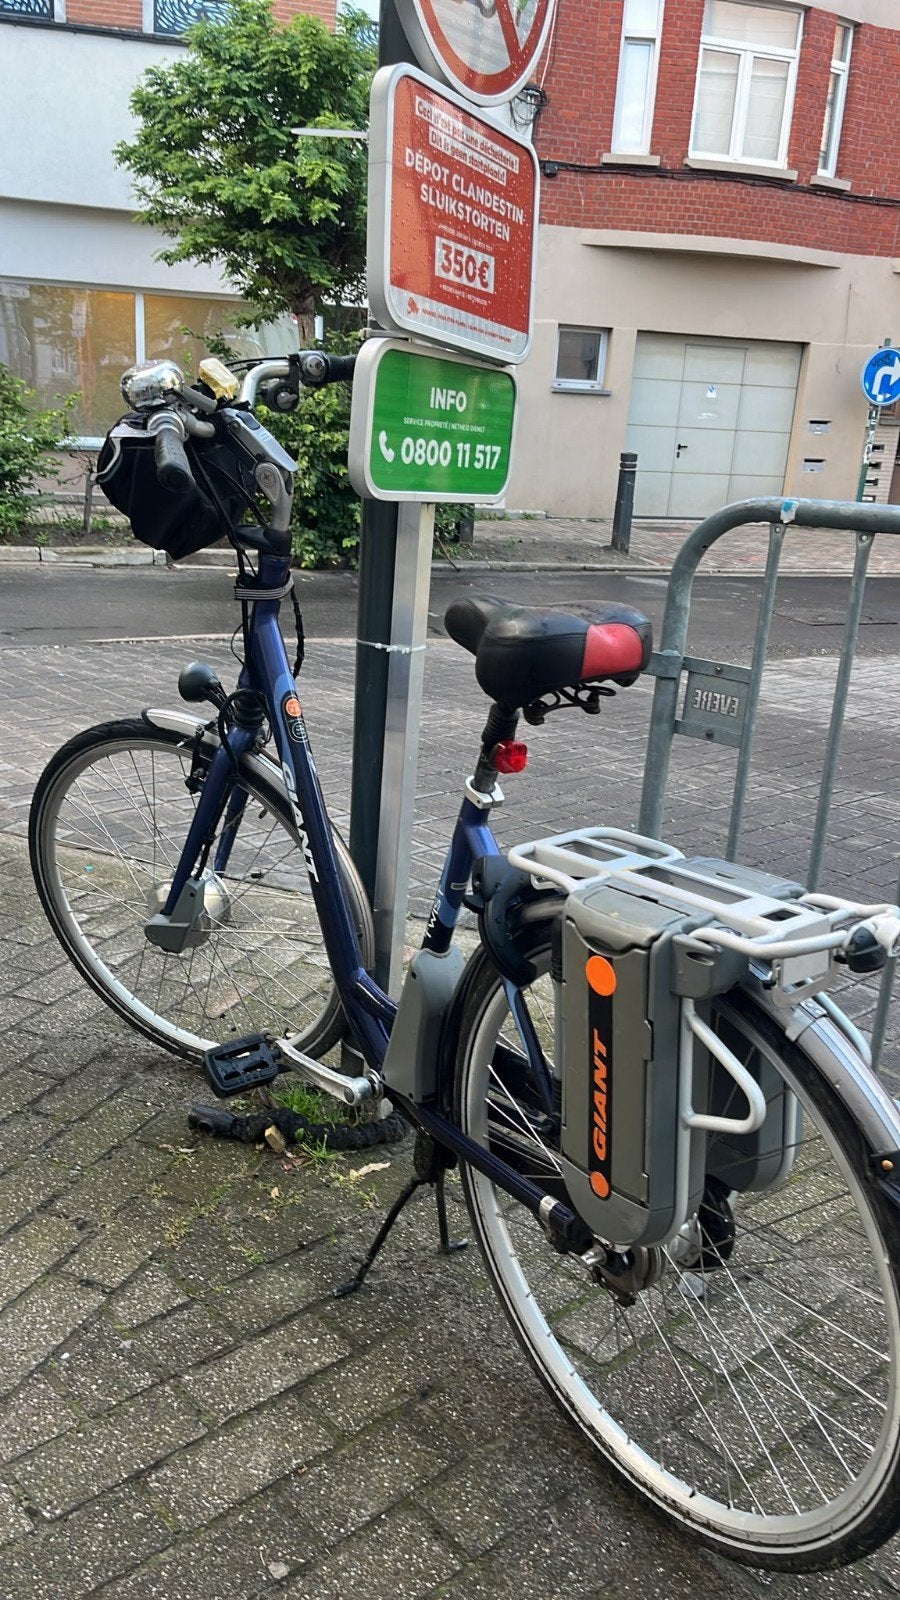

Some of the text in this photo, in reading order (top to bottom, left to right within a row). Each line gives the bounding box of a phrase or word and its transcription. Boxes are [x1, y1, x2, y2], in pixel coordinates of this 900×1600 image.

[466, 133, 478, 147] une
[405, 147, 524, 225] DÉPOT CLANDESTIN
[420, 183, 510, 242] SLUIKSTORTEN
[440, 243, 490, 288] 350€
[430, 387, 467, 412] INFO
[403, 417, 424, 426] SERVICE
[401, 437, 501, 470] 0800 11 517
[593, 1028, 607, 1161] GIANT
